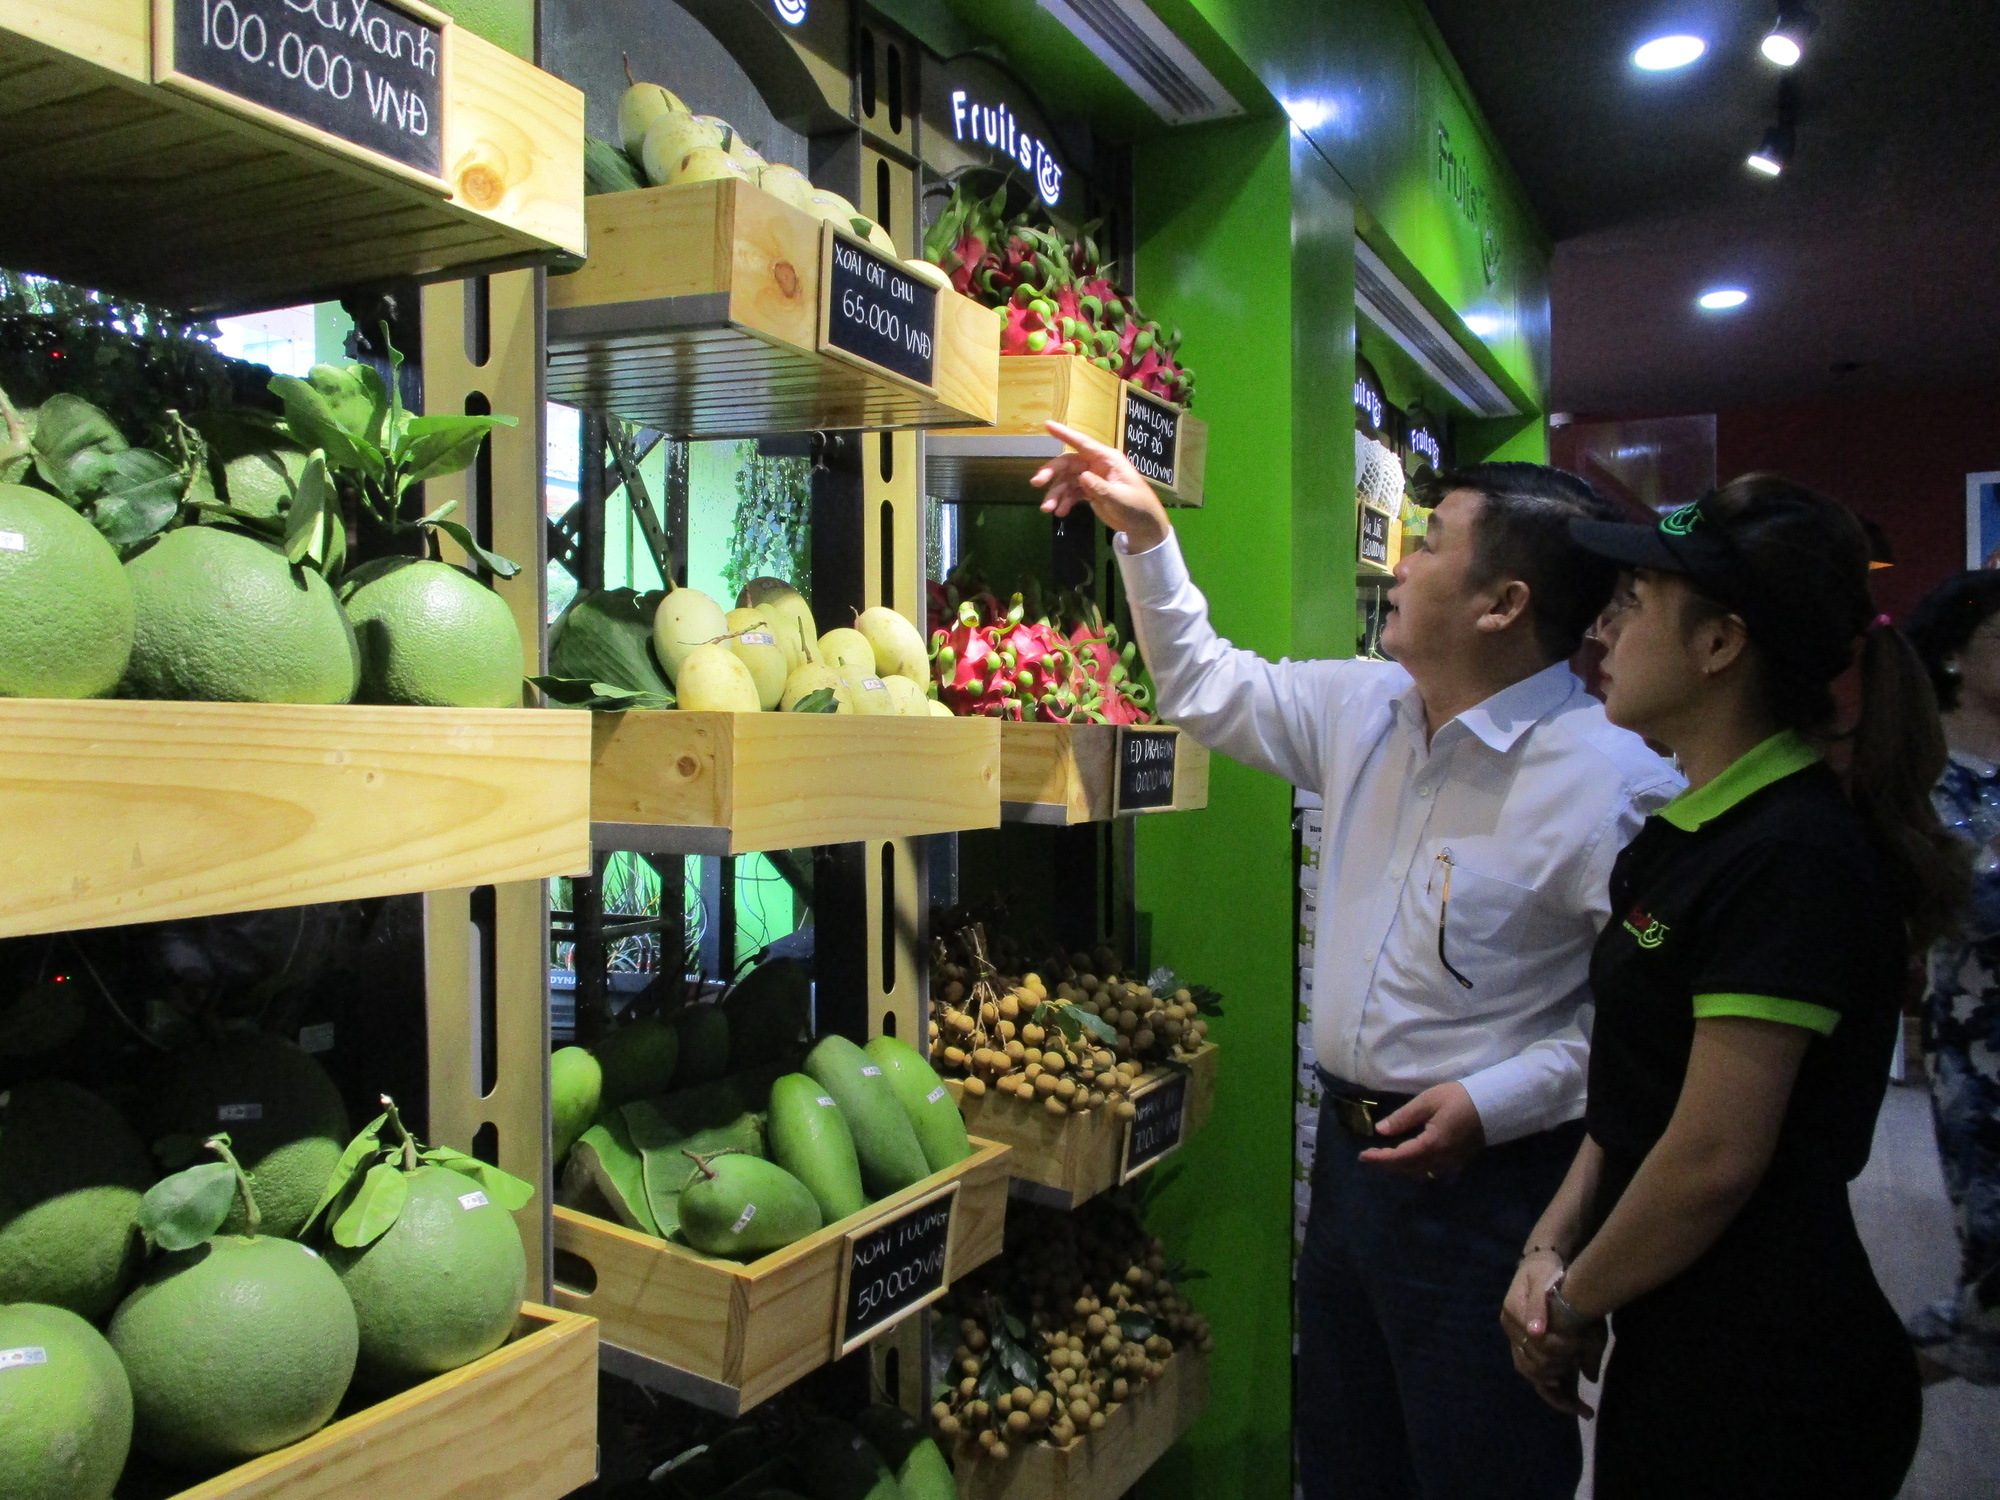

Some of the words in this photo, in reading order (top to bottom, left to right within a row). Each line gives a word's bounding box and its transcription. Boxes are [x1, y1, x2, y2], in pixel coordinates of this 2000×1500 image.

[202, 0, 353, 100] 100.000
[364, 70, 428, 137] VNĐ
[952, 90, 1032, 170] Fruits
[842, 288, 900, 342] 65.000
[1151, 410, 1174, 438] LONG
[1410, 427, 1432, 456] Fruits
[857, 1258, 922, 1321] 50.000
